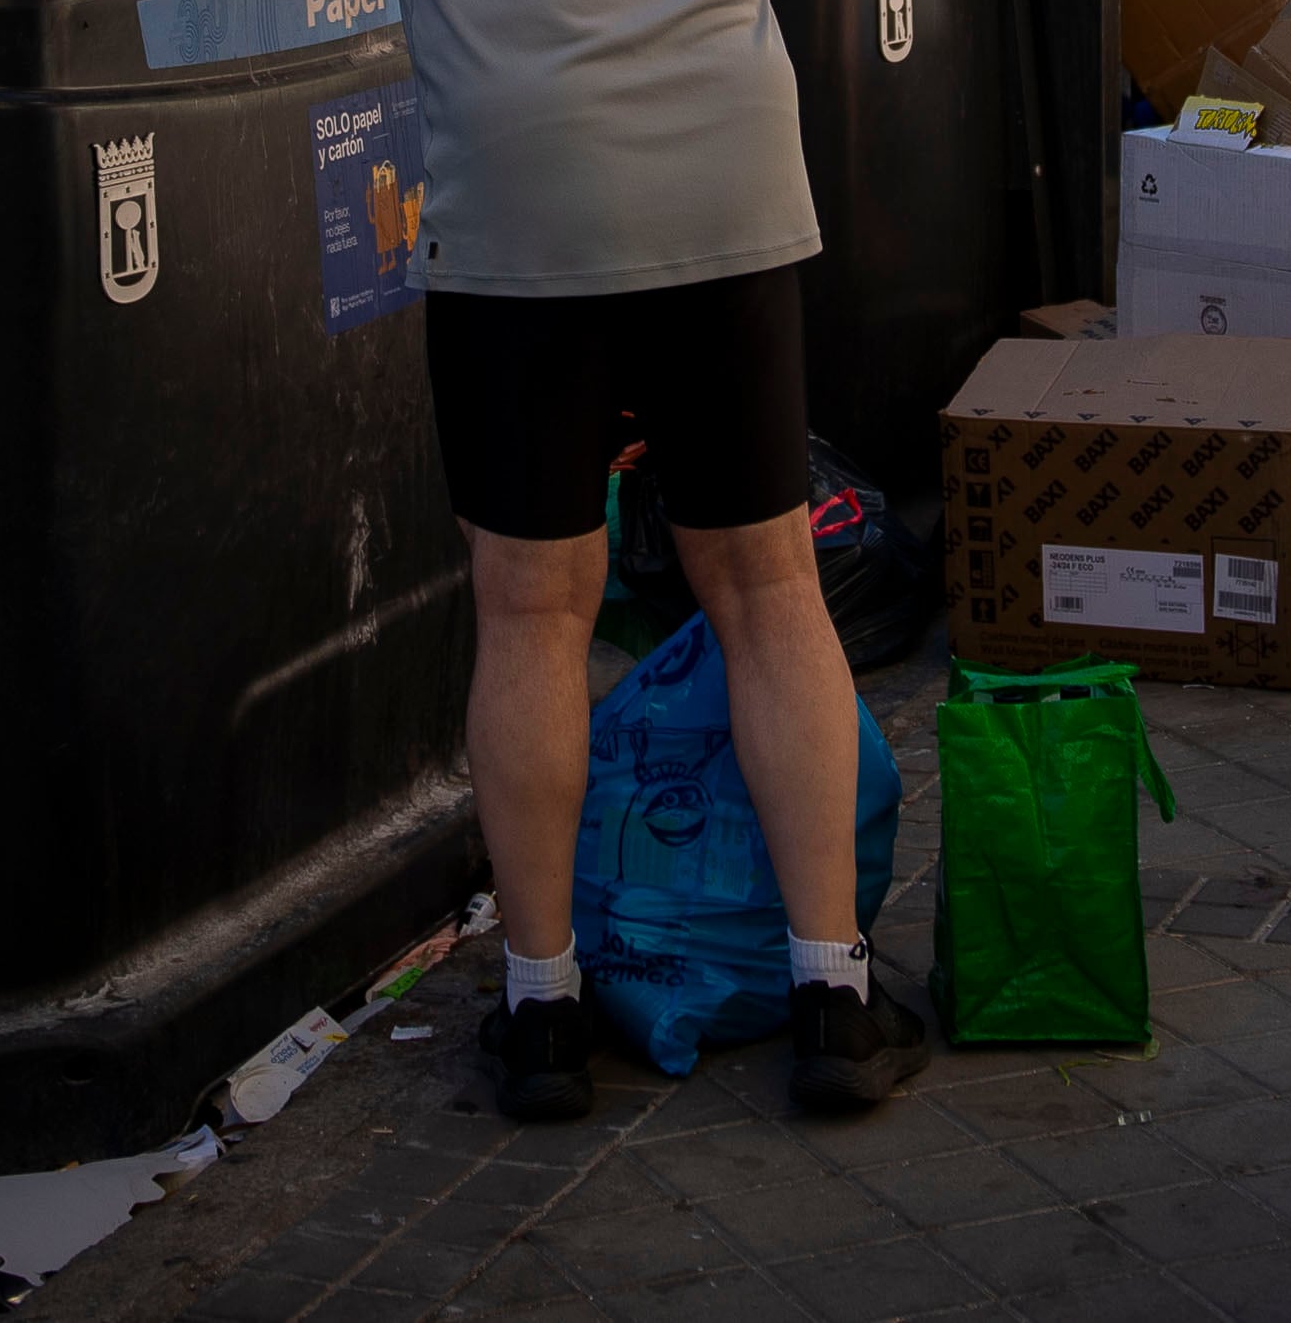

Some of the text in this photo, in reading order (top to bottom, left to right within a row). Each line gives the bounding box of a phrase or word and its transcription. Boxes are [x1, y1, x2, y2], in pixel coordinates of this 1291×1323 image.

[316, 111, 351, 141] SOLO
[352, 102, 383, 136] papel
[318, 134, 364, 170] y cartón
[1022, 426, 1066, 469] BAXI
[1075, 428, 1119, 472] BAXI
[1127, 430, 1173, 475] BAXI
[1181, 432, 1227, 478] BAXI
[1236, 434, 1282, 479] BAXI
[1023, 480, 1068, 524] BAXI
[1076, 482, 1121, 526] BAXI
[1129, 484, 1174, 529] BAXI
[1184, 486, 1229, 532] BAXI
[1238, 489, 1284, 534] BAXI
[1086, 555, 1106, 564] PLUS
